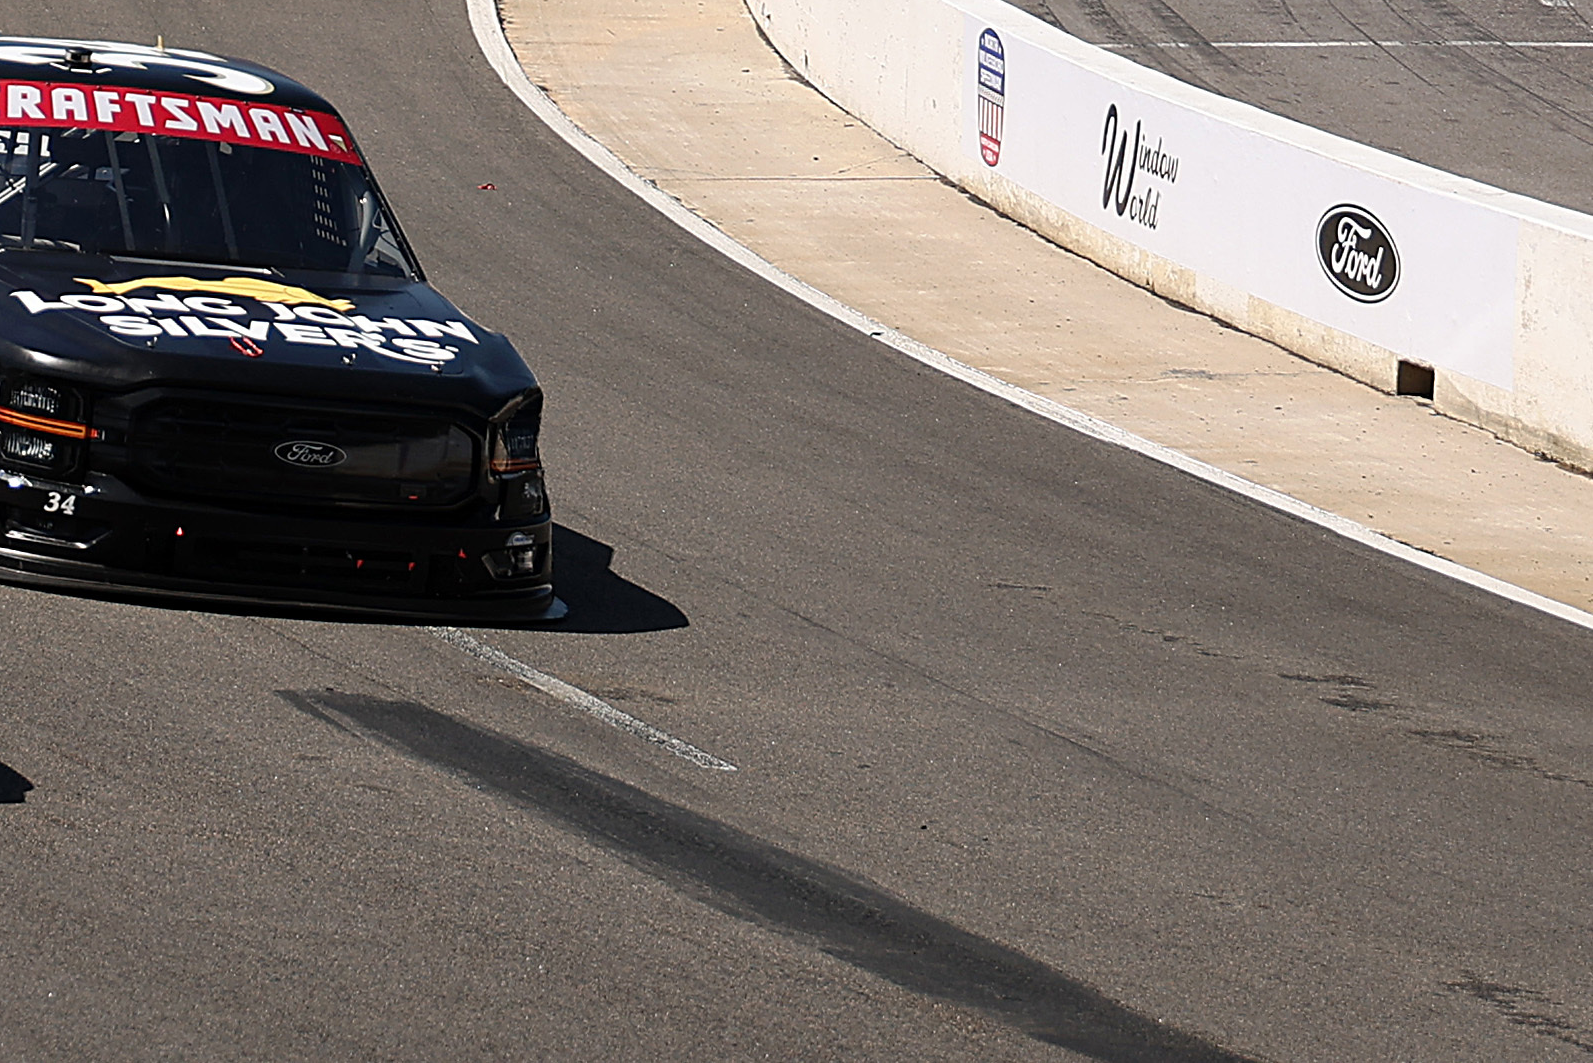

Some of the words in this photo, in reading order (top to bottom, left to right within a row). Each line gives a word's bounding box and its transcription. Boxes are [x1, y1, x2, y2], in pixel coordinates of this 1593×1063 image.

[1101, 102, 1180, 216] Window
[1331, 214, 1383, 293] Ford
[9, 290, 248, 315] LONG
[261, 301, 480, 345] JOHN
[286, 443, 333, 466] Ford
[43, 491, 77, 516] 34
